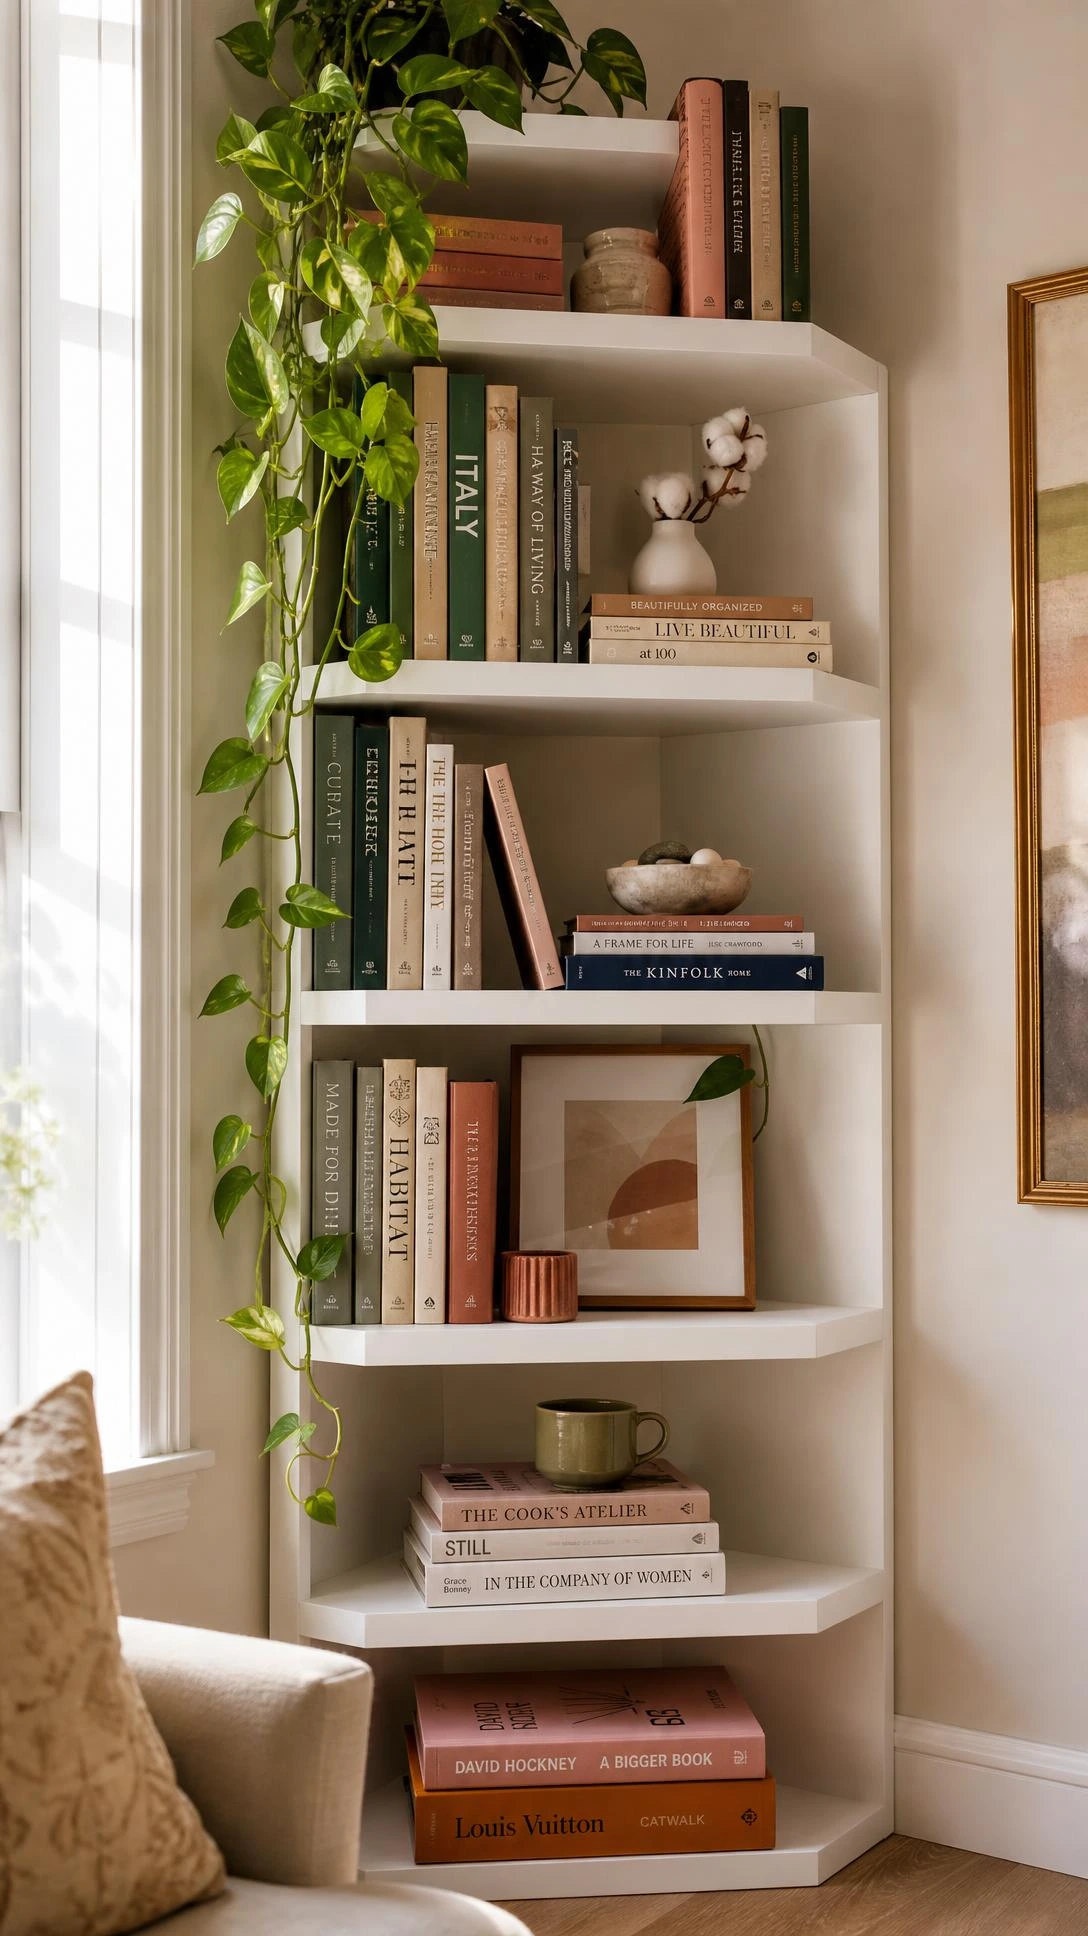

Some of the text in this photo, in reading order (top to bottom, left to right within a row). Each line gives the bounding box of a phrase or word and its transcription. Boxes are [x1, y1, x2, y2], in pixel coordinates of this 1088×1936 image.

[455, 454, 479, 539] ITALY
[531, 473, 544, 507] WAY
[531, 510, 544, 533] OF
[530, 537, 544, 595] LIVING
[631, 601, 763, 612] BEAUTIFULLY ORGANIZED
[655, 622, 695, 639] LIVE
[700, 623, 796, 640] BEAUTIFUL
[639, 648, 677, 659] at 100
[326, 762, 342, 846] CURATE
[593, 939, 694, 949] A FRAME FOR LIFE
[646, 967, 724, 979] KINFOLK
[325, 1082, 339, 1139] MADE
[325, 1145, 339, 1183] FOR
[388, 1137, 410, 1262] HABITAT
[461, 1504, 648, 1523] THE COOK'S ATELIER
[445, 1539, 491, 1557] STILL
[443, 1577, 467, 1585] Grace
[484, 1569, 693, 1591] IN THE COMPANY OF WOMEN
[443, 1585, 472, 1595] Bonney
[455, 1757, 577, 1774] DAVID HOCKNEY
[600, 1752, 713, 1769] A BIGGER BOOK
[455, 1816, 516, 1840] Louis
[523, 1813, 605, 1837] Vuitton
[640, 1814, 705, 1828] CATWALK
